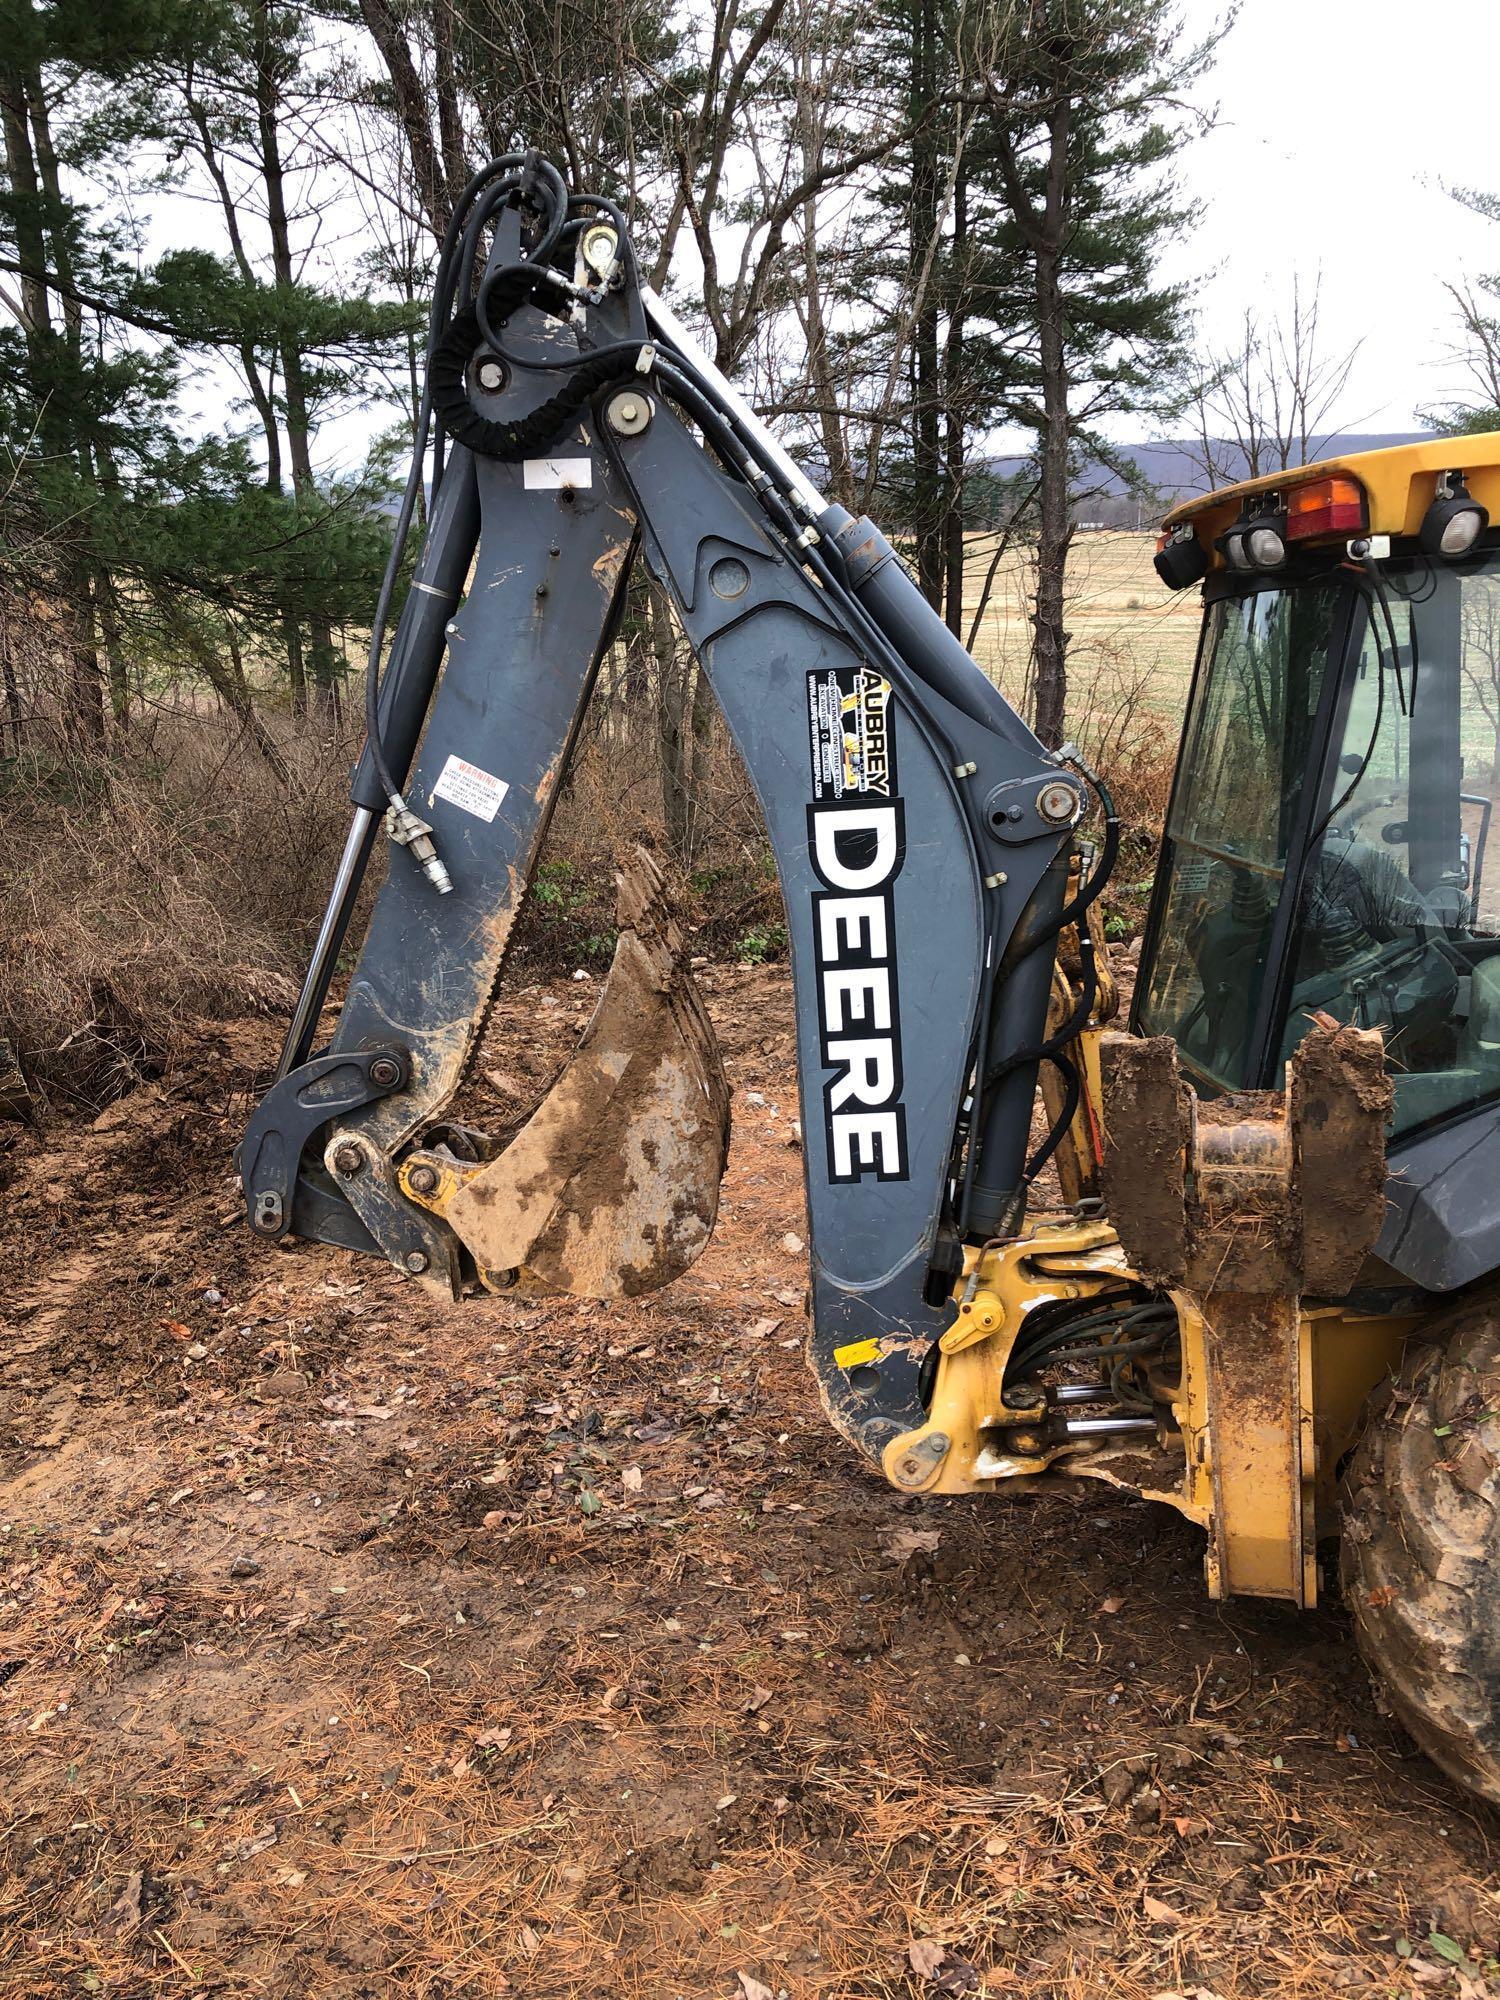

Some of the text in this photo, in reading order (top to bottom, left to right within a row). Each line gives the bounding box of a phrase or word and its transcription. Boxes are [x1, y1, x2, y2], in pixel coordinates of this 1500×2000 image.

[458, 761, 497, 788] WARNING
[808, 675, 822, 798] WWW.AUBREYENTERPRISESPA.COM
[819, 684, 831, 782] EXCAVATION CONCRETE
[828, 676, 842, 793] NEW HOME CONSTRUCTION
[861, 668, 889, 795] AUBREY
[814, 806, 900, 1177] DEERE
